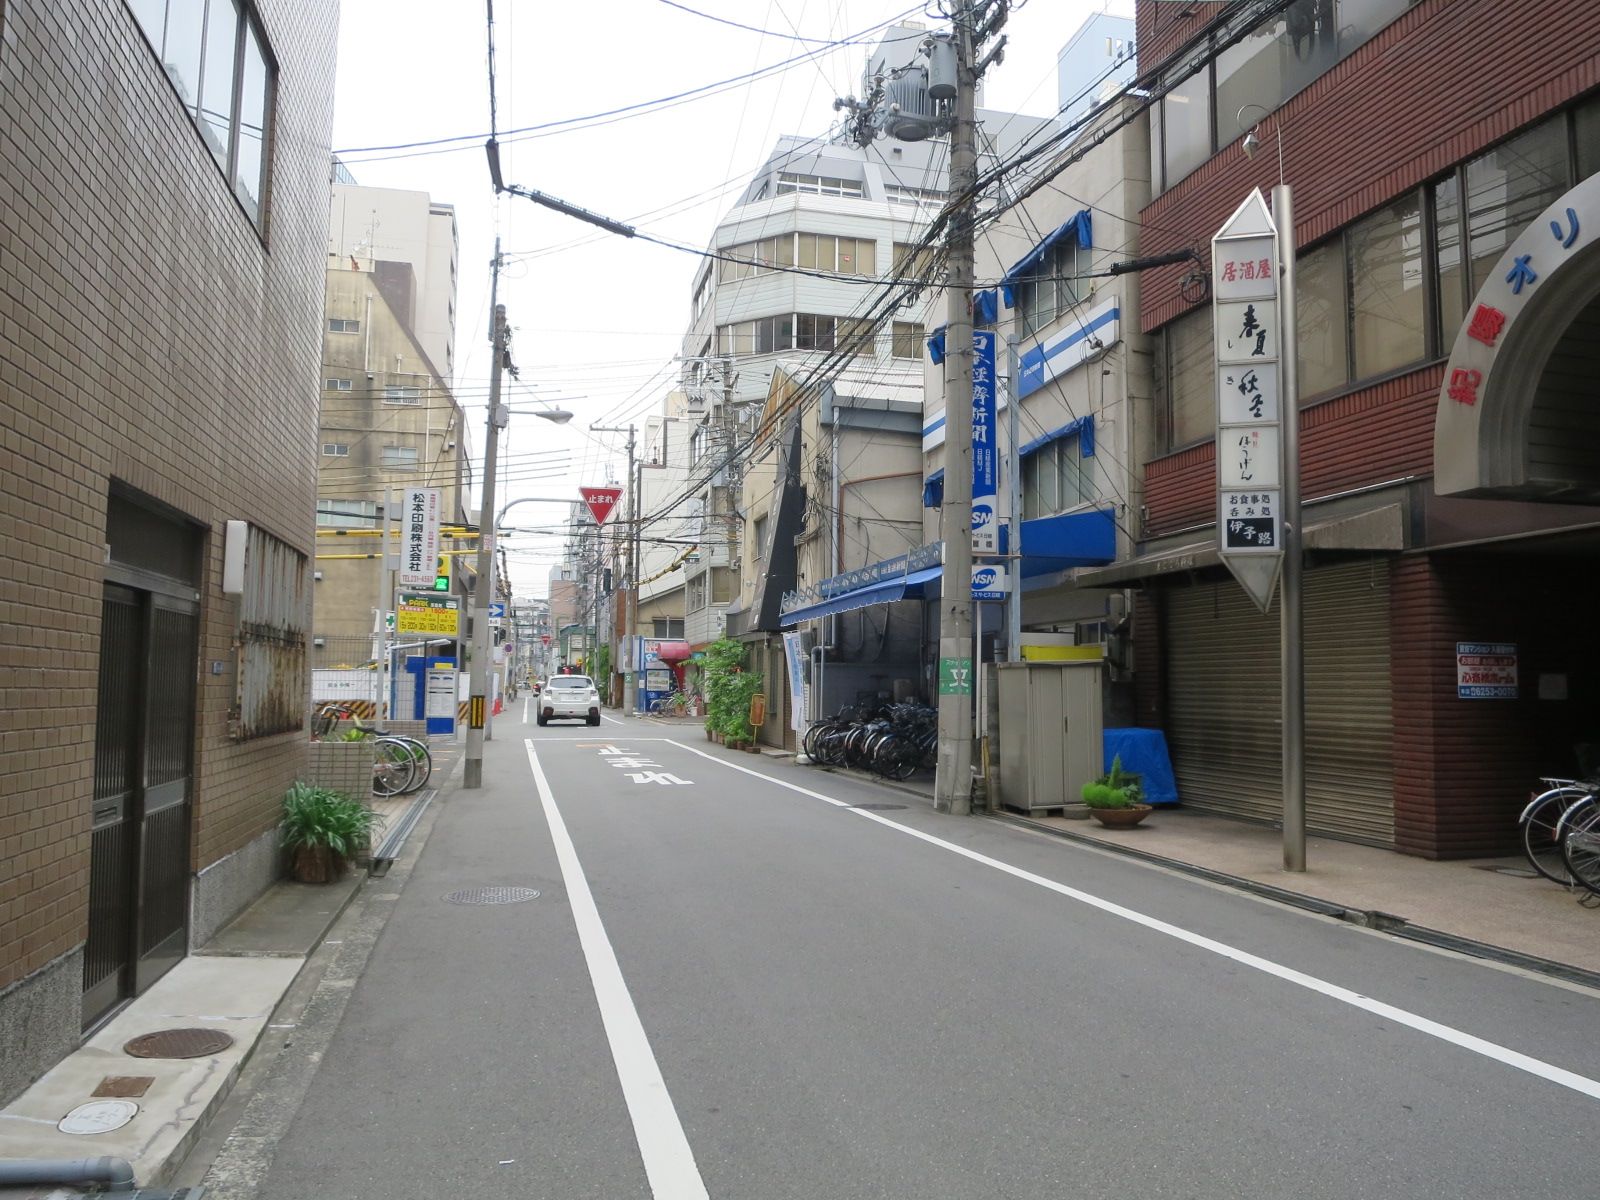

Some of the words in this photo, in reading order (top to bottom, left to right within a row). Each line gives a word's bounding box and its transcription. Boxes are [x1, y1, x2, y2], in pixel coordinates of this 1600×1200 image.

[1221, 258, 1272, 282] 居酒屋
[588, 495, 613, 504] 止まれ
[1229, 494, 1270, 505] お食事処
[1230, 507, 1271, 516] 呑み処
[408, 493, 425, 572] 松本印刷株式会社
[597, 745, 696, 785] 止まれ
